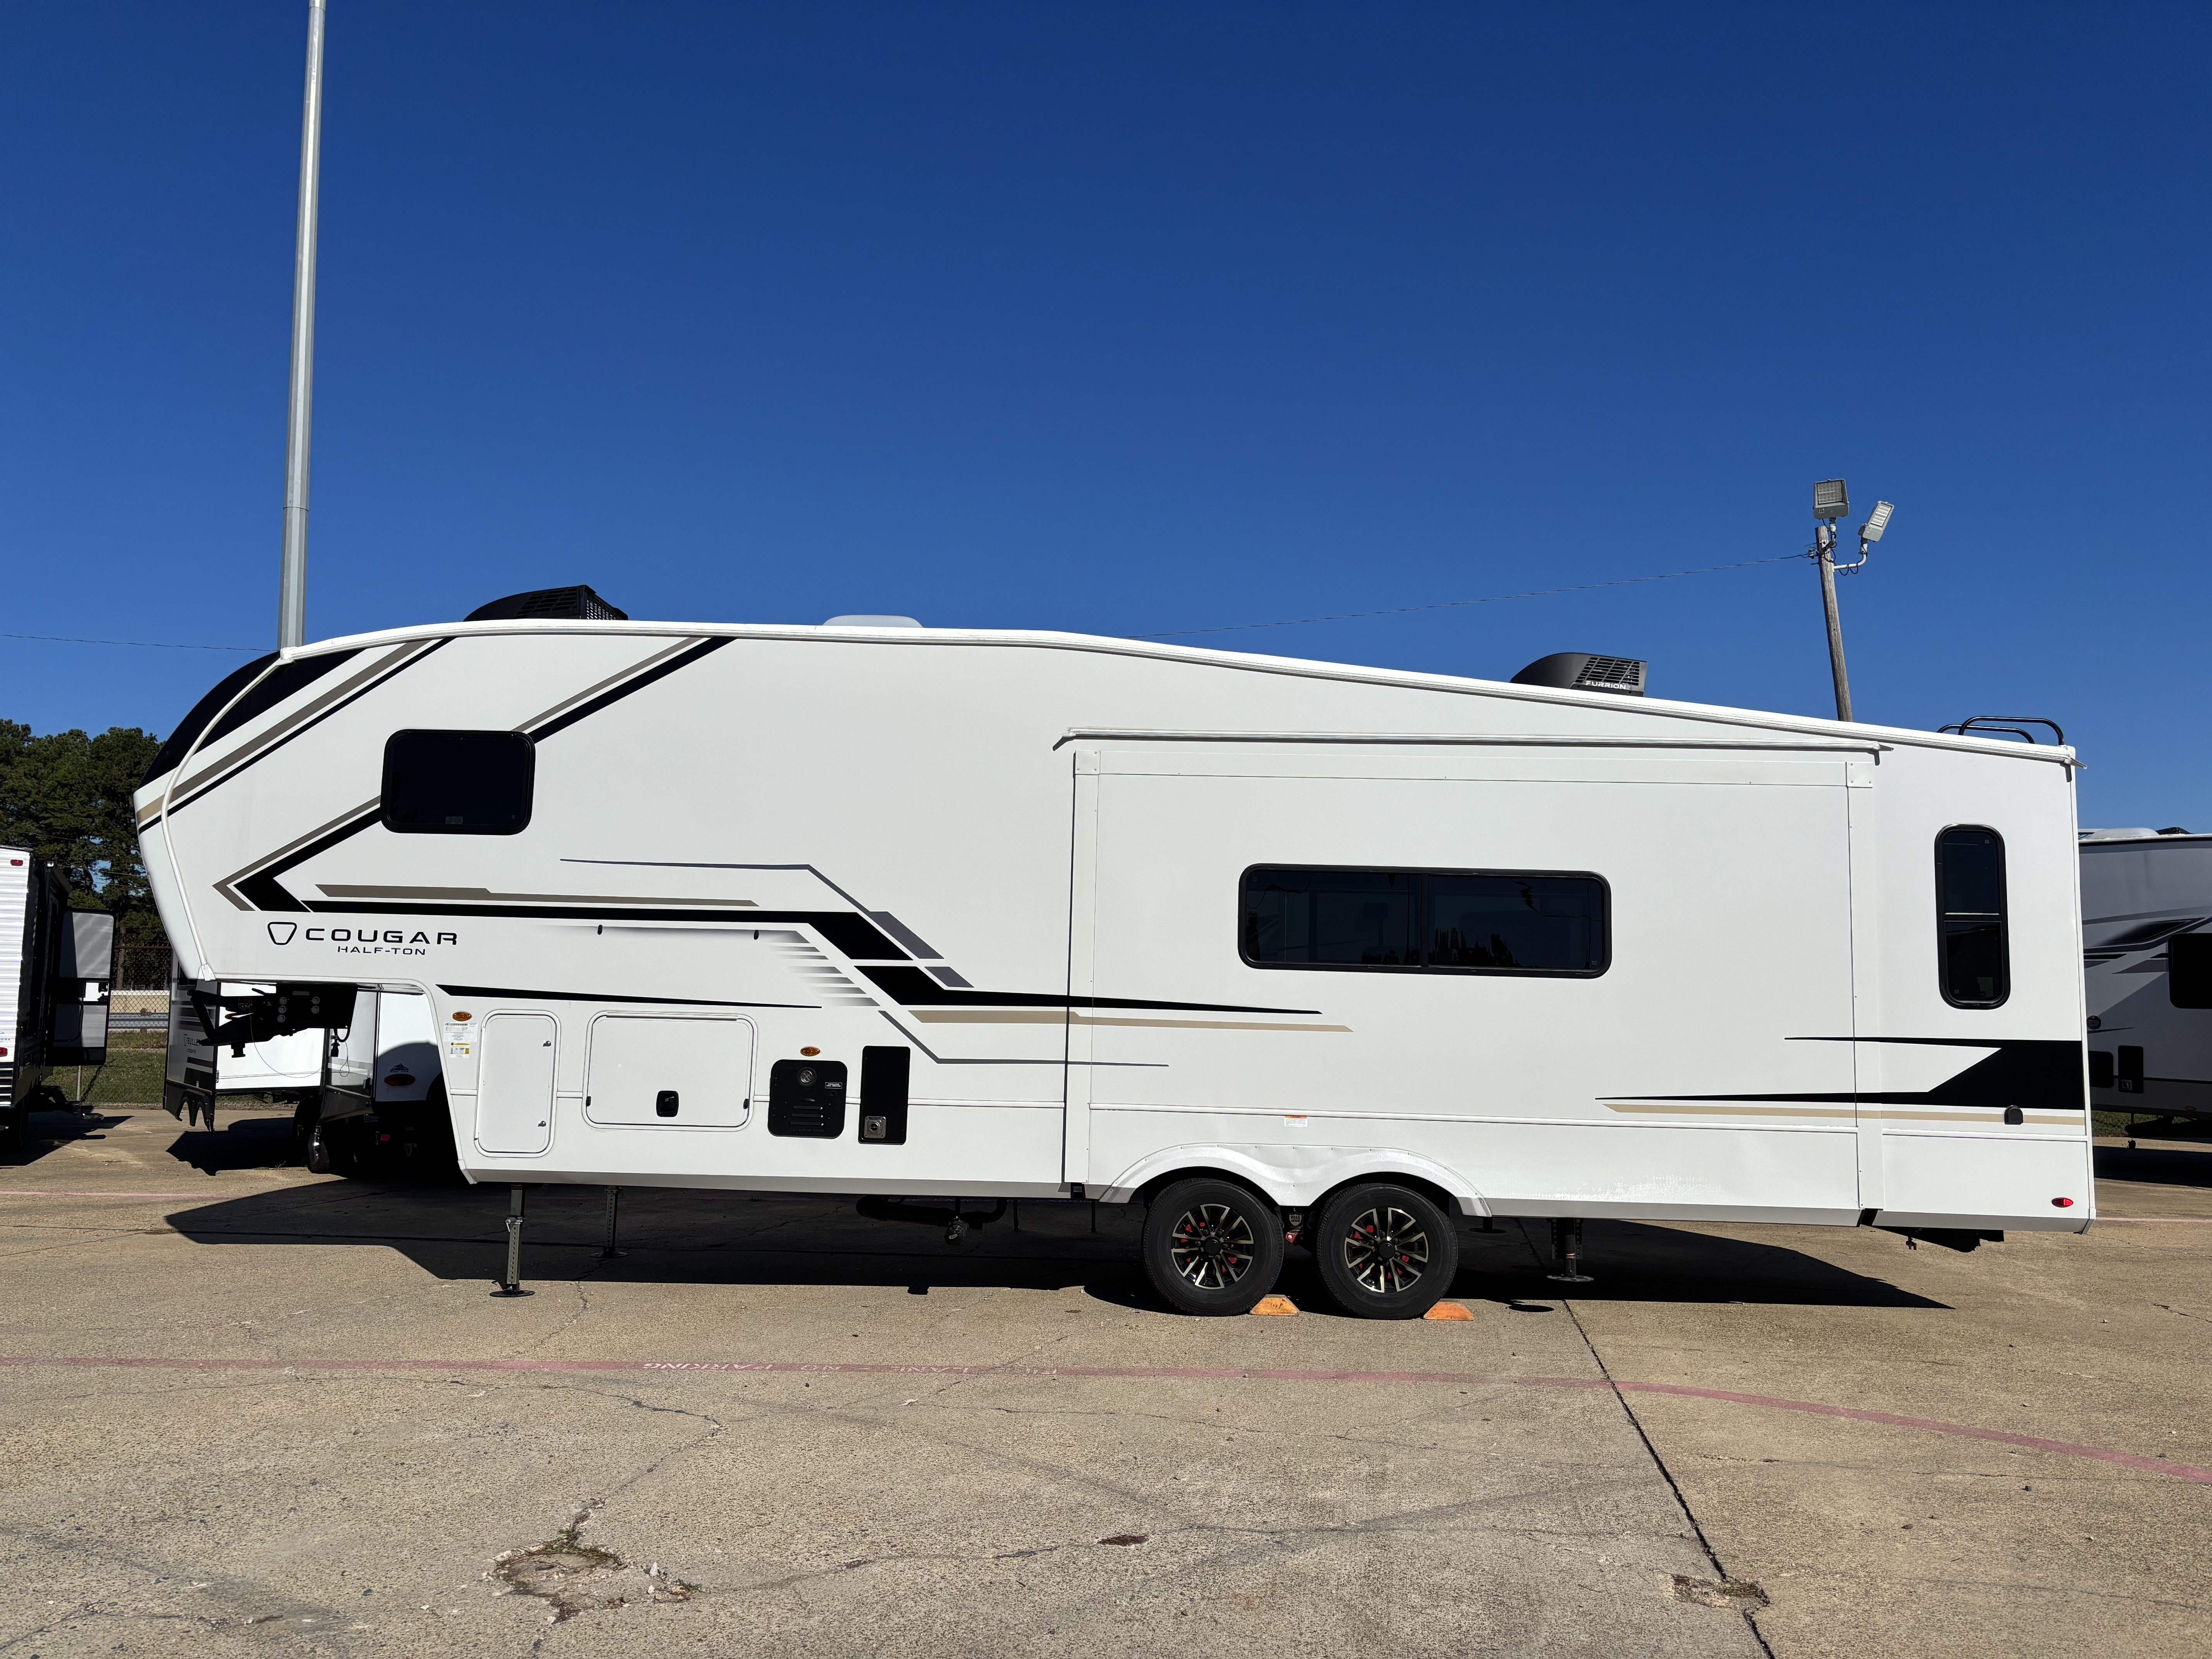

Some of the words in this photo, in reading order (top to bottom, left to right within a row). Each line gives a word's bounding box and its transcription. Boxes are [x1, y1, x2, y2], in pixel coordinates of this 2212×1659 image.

[1586, 680, 1626, 690] FURRION
[306, 928, 457, 945] COUGAR
[338, 946, 426, 955] HALF-TON
[187, 1037, 200, 1046] BULLE
